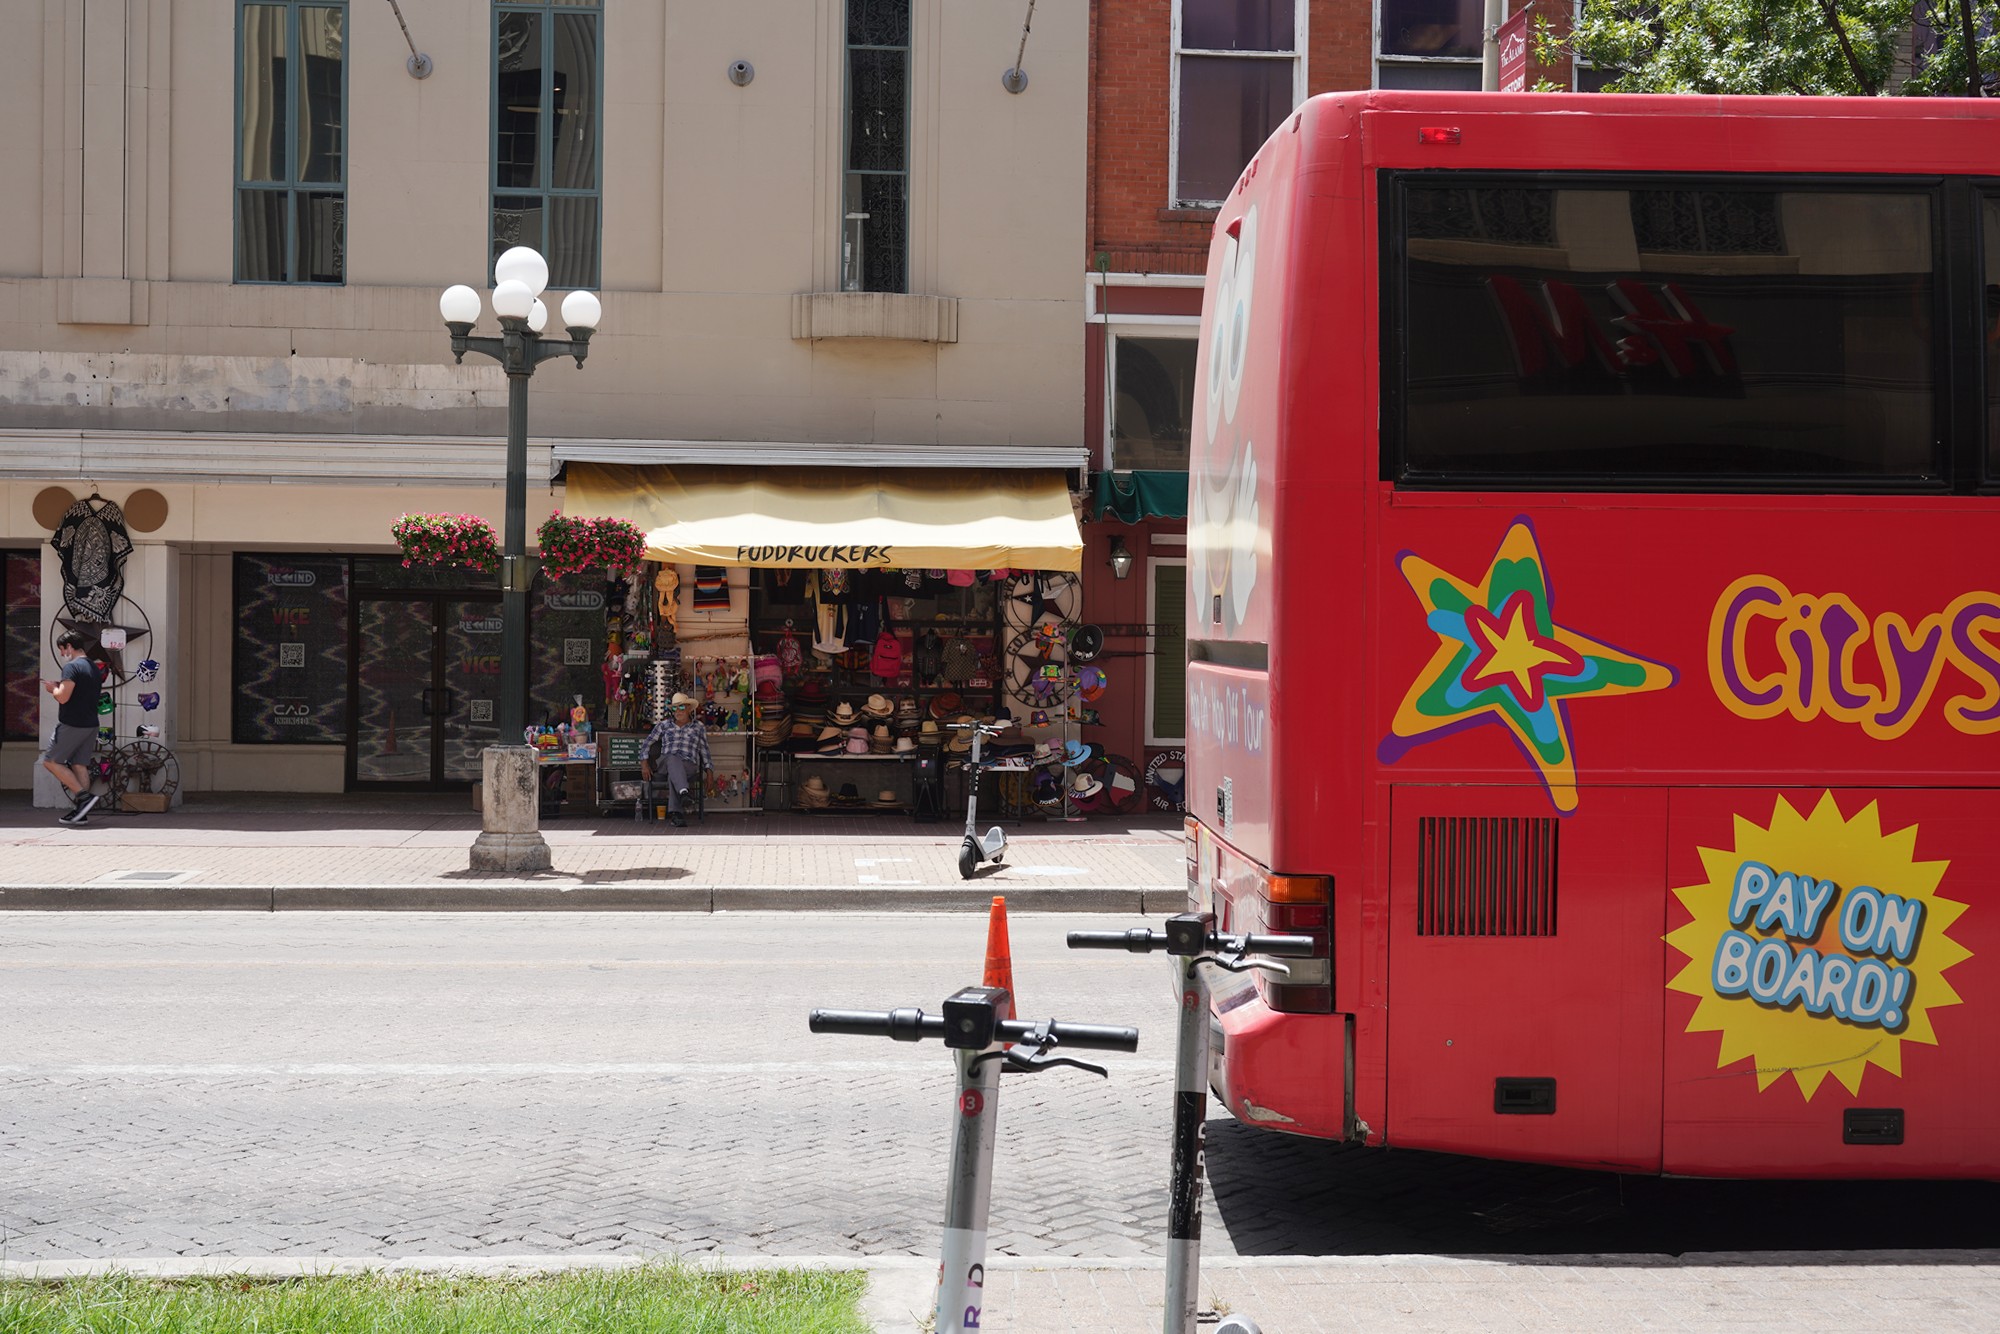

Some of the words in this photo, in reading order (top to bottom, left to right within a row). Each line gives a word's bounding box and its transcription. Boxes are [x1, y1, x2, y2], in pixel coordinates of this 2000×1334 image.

[738, 545, 893, 564] FUDDRUCKERS
[272, 607, 310, 624] VICE
[461, 656, 501, 673] VICE
[1226, 686, 1239, 743] Off
[1242, 688, 1264, 751] Tour
[1145, 753, 1167, 784] UNITED
[1153, 796, 1169, 811] AIR
[1728, 860, 1834, 939] PAY
[1839, 885, 1921, 959] ON
[1711, 929, 1910, 1028] BOARD!
[966, 1095, 976, 1110] 3
